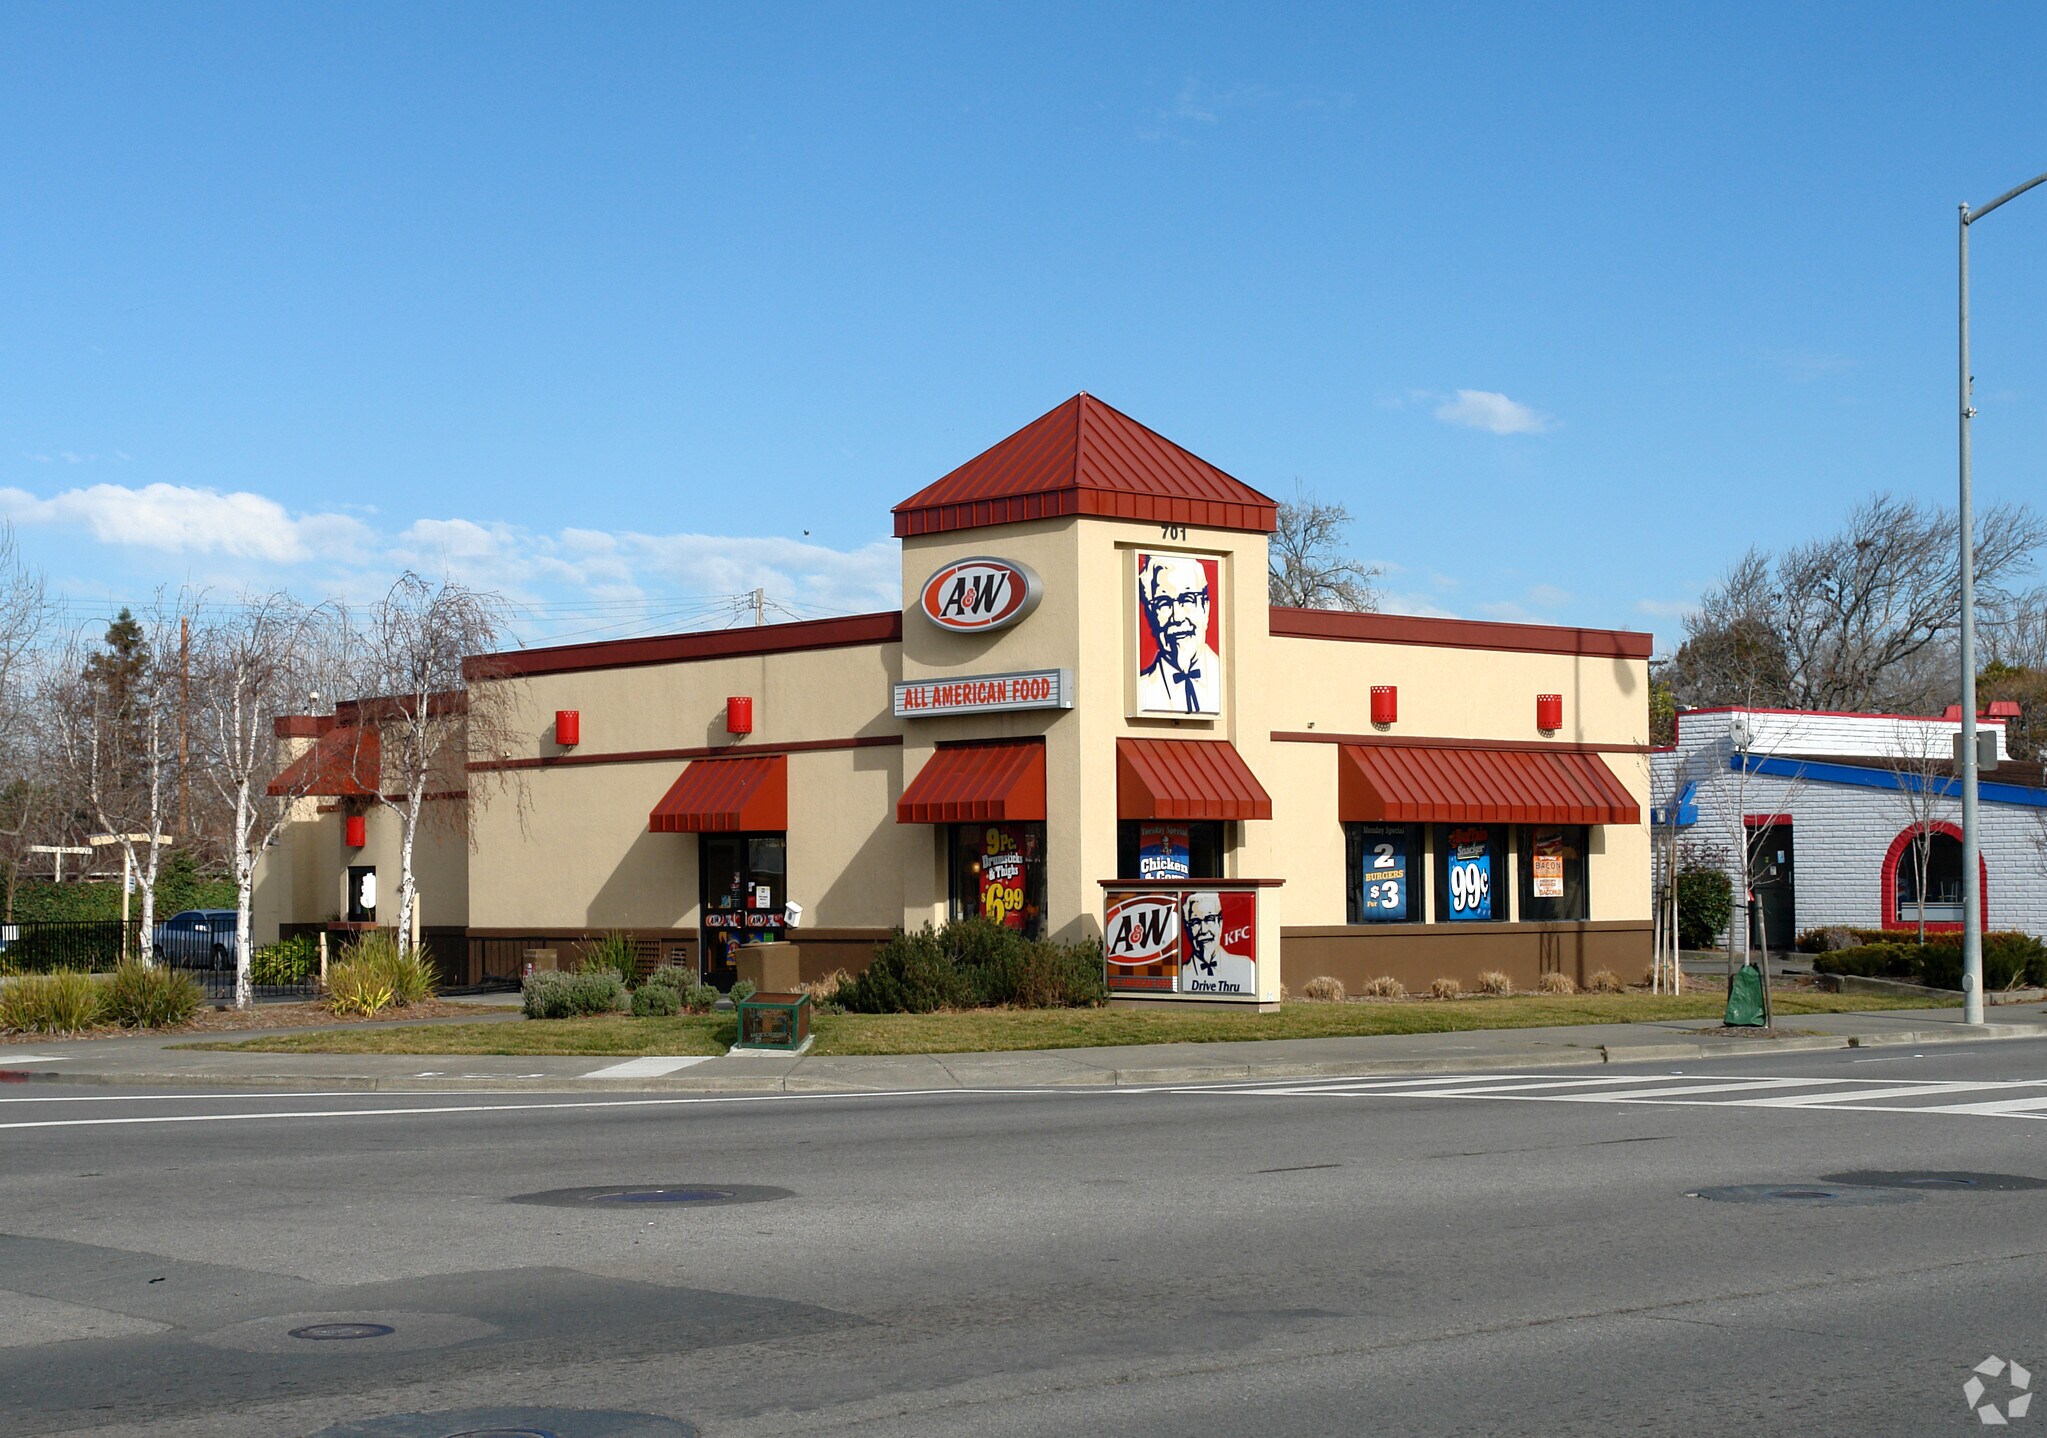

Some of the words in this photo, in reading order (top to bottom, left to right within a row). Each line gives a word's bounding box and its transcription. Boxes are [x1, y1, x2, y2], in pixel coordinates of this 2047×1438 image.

[1161, 524, 1186, 541] 701
[940, 573, 1009, 618] A&W
[904, 688, 928, 710] ALL
[932, 680, 1007, 708] AMERICAN
[1012, 678, 1050, 700] FOOD
[986, 828, 1000, 855] 9
[982, 852, 1024, 869] Drumsticks
[1141, 856, 1188, 874] Chicken
[1373, 843, 1395, 868] 2
[996, 864, 1019, 880] Thighs
[1365, 869, 1404, 882] BURGERS
[1451, 863, 1489, 911] 99¢
[1110, 906, 1172, 956] A&W
[1224, 926, 1250, 946] KFC
[1191, 980, 1216, 992] Drive
[1218, 980, 1240, 992] Thru
